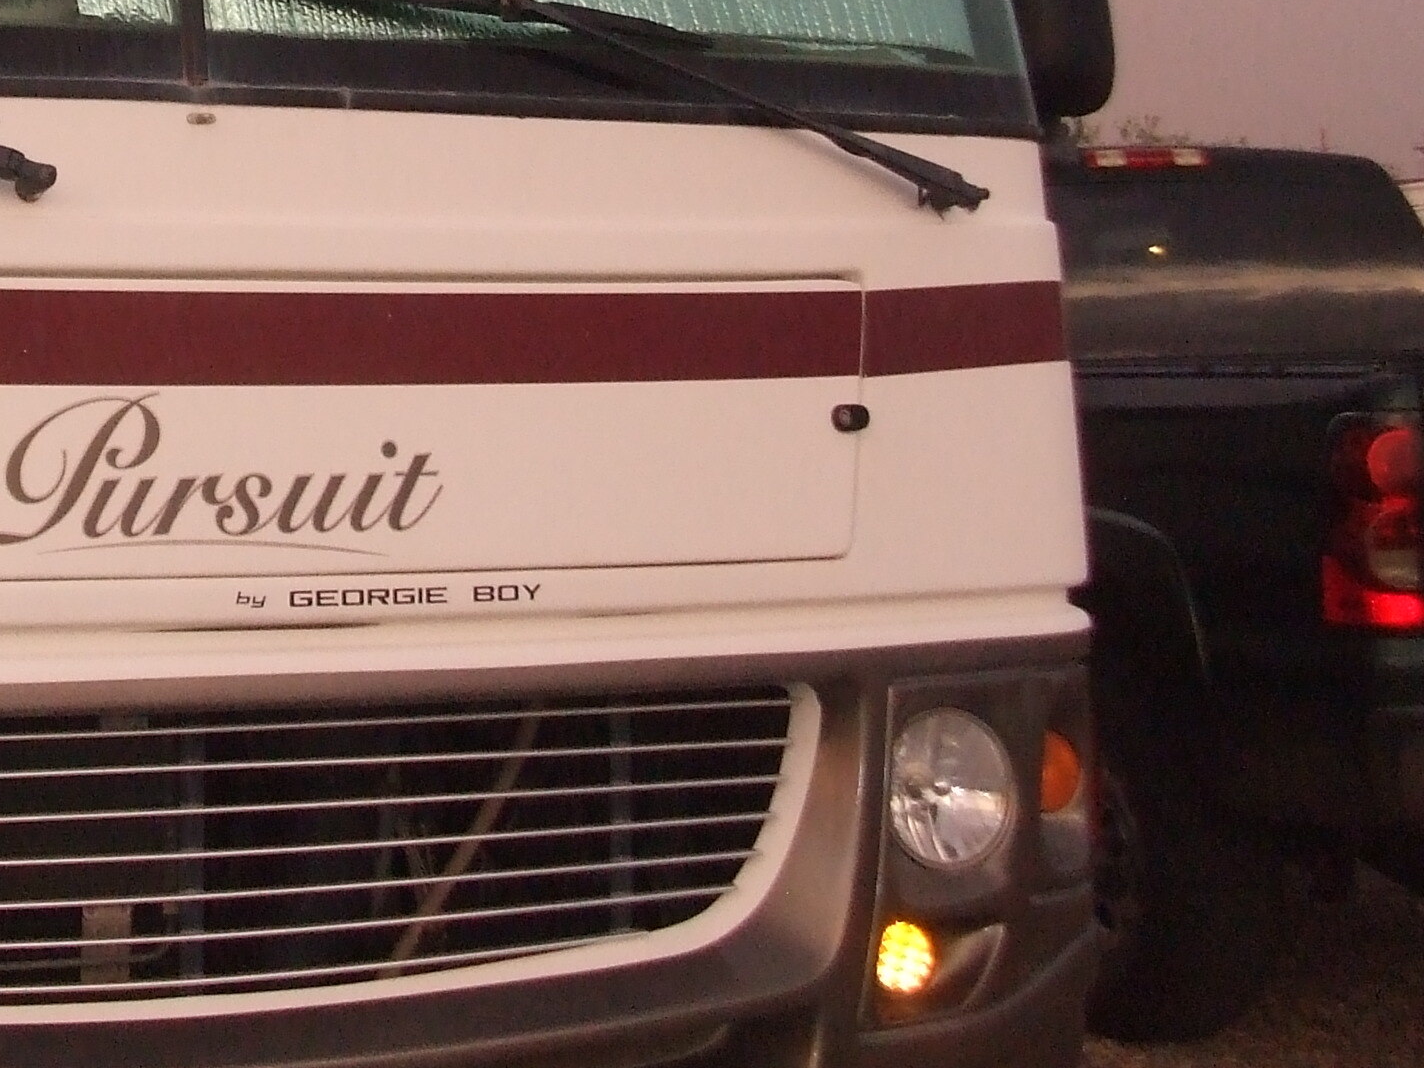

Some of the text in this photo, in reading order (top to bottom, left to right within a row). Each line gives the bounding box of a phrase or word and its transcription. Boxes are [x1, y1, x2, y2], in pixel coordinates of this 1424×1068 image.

[235, 584, 542, 609] by GEORGIE BOY
